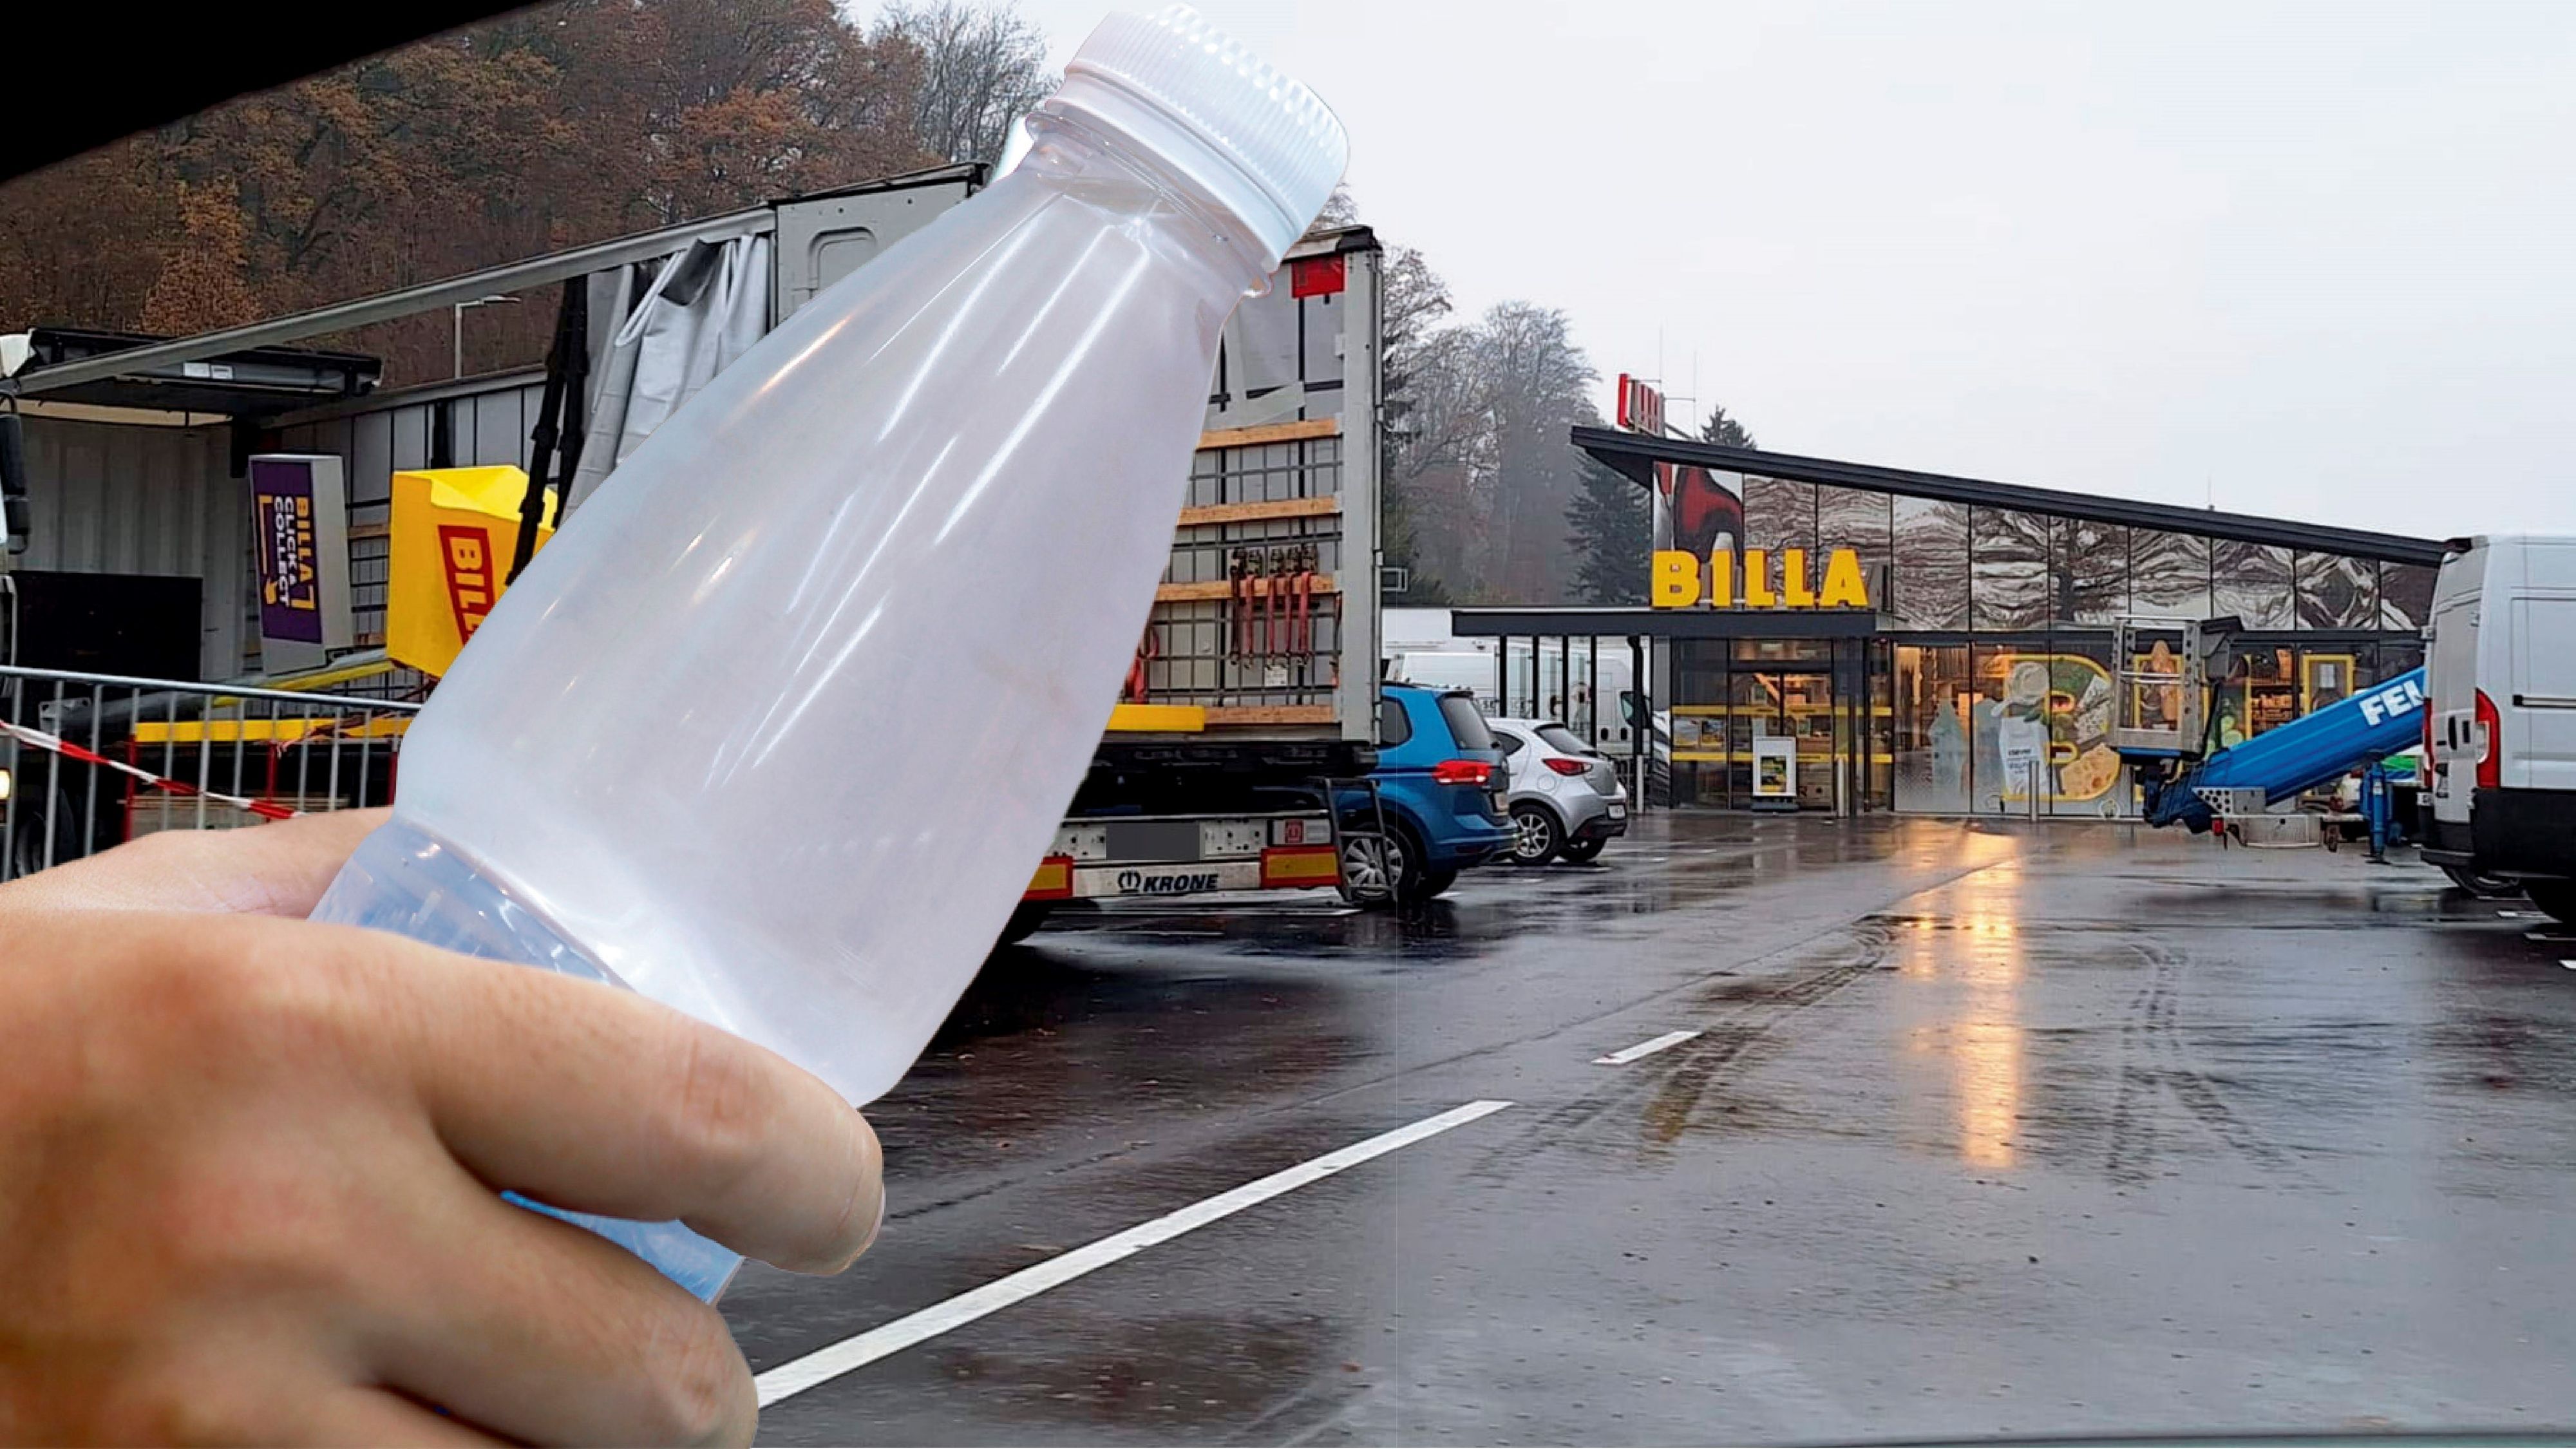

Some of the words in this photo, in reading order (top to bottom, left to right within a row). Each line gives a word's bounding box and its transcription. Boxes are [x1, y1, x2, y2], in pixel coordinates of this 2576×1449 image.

[274, 496, 290, 607] COLLECT
[285, 497, 297, 570] CLICK
[296, 497, 314, 582] BILLA
[449, 536, 487, 638] BILL
[1651, 548, 1869, 608] BILLA
[1143, 874, 1218, 892] KRONE
